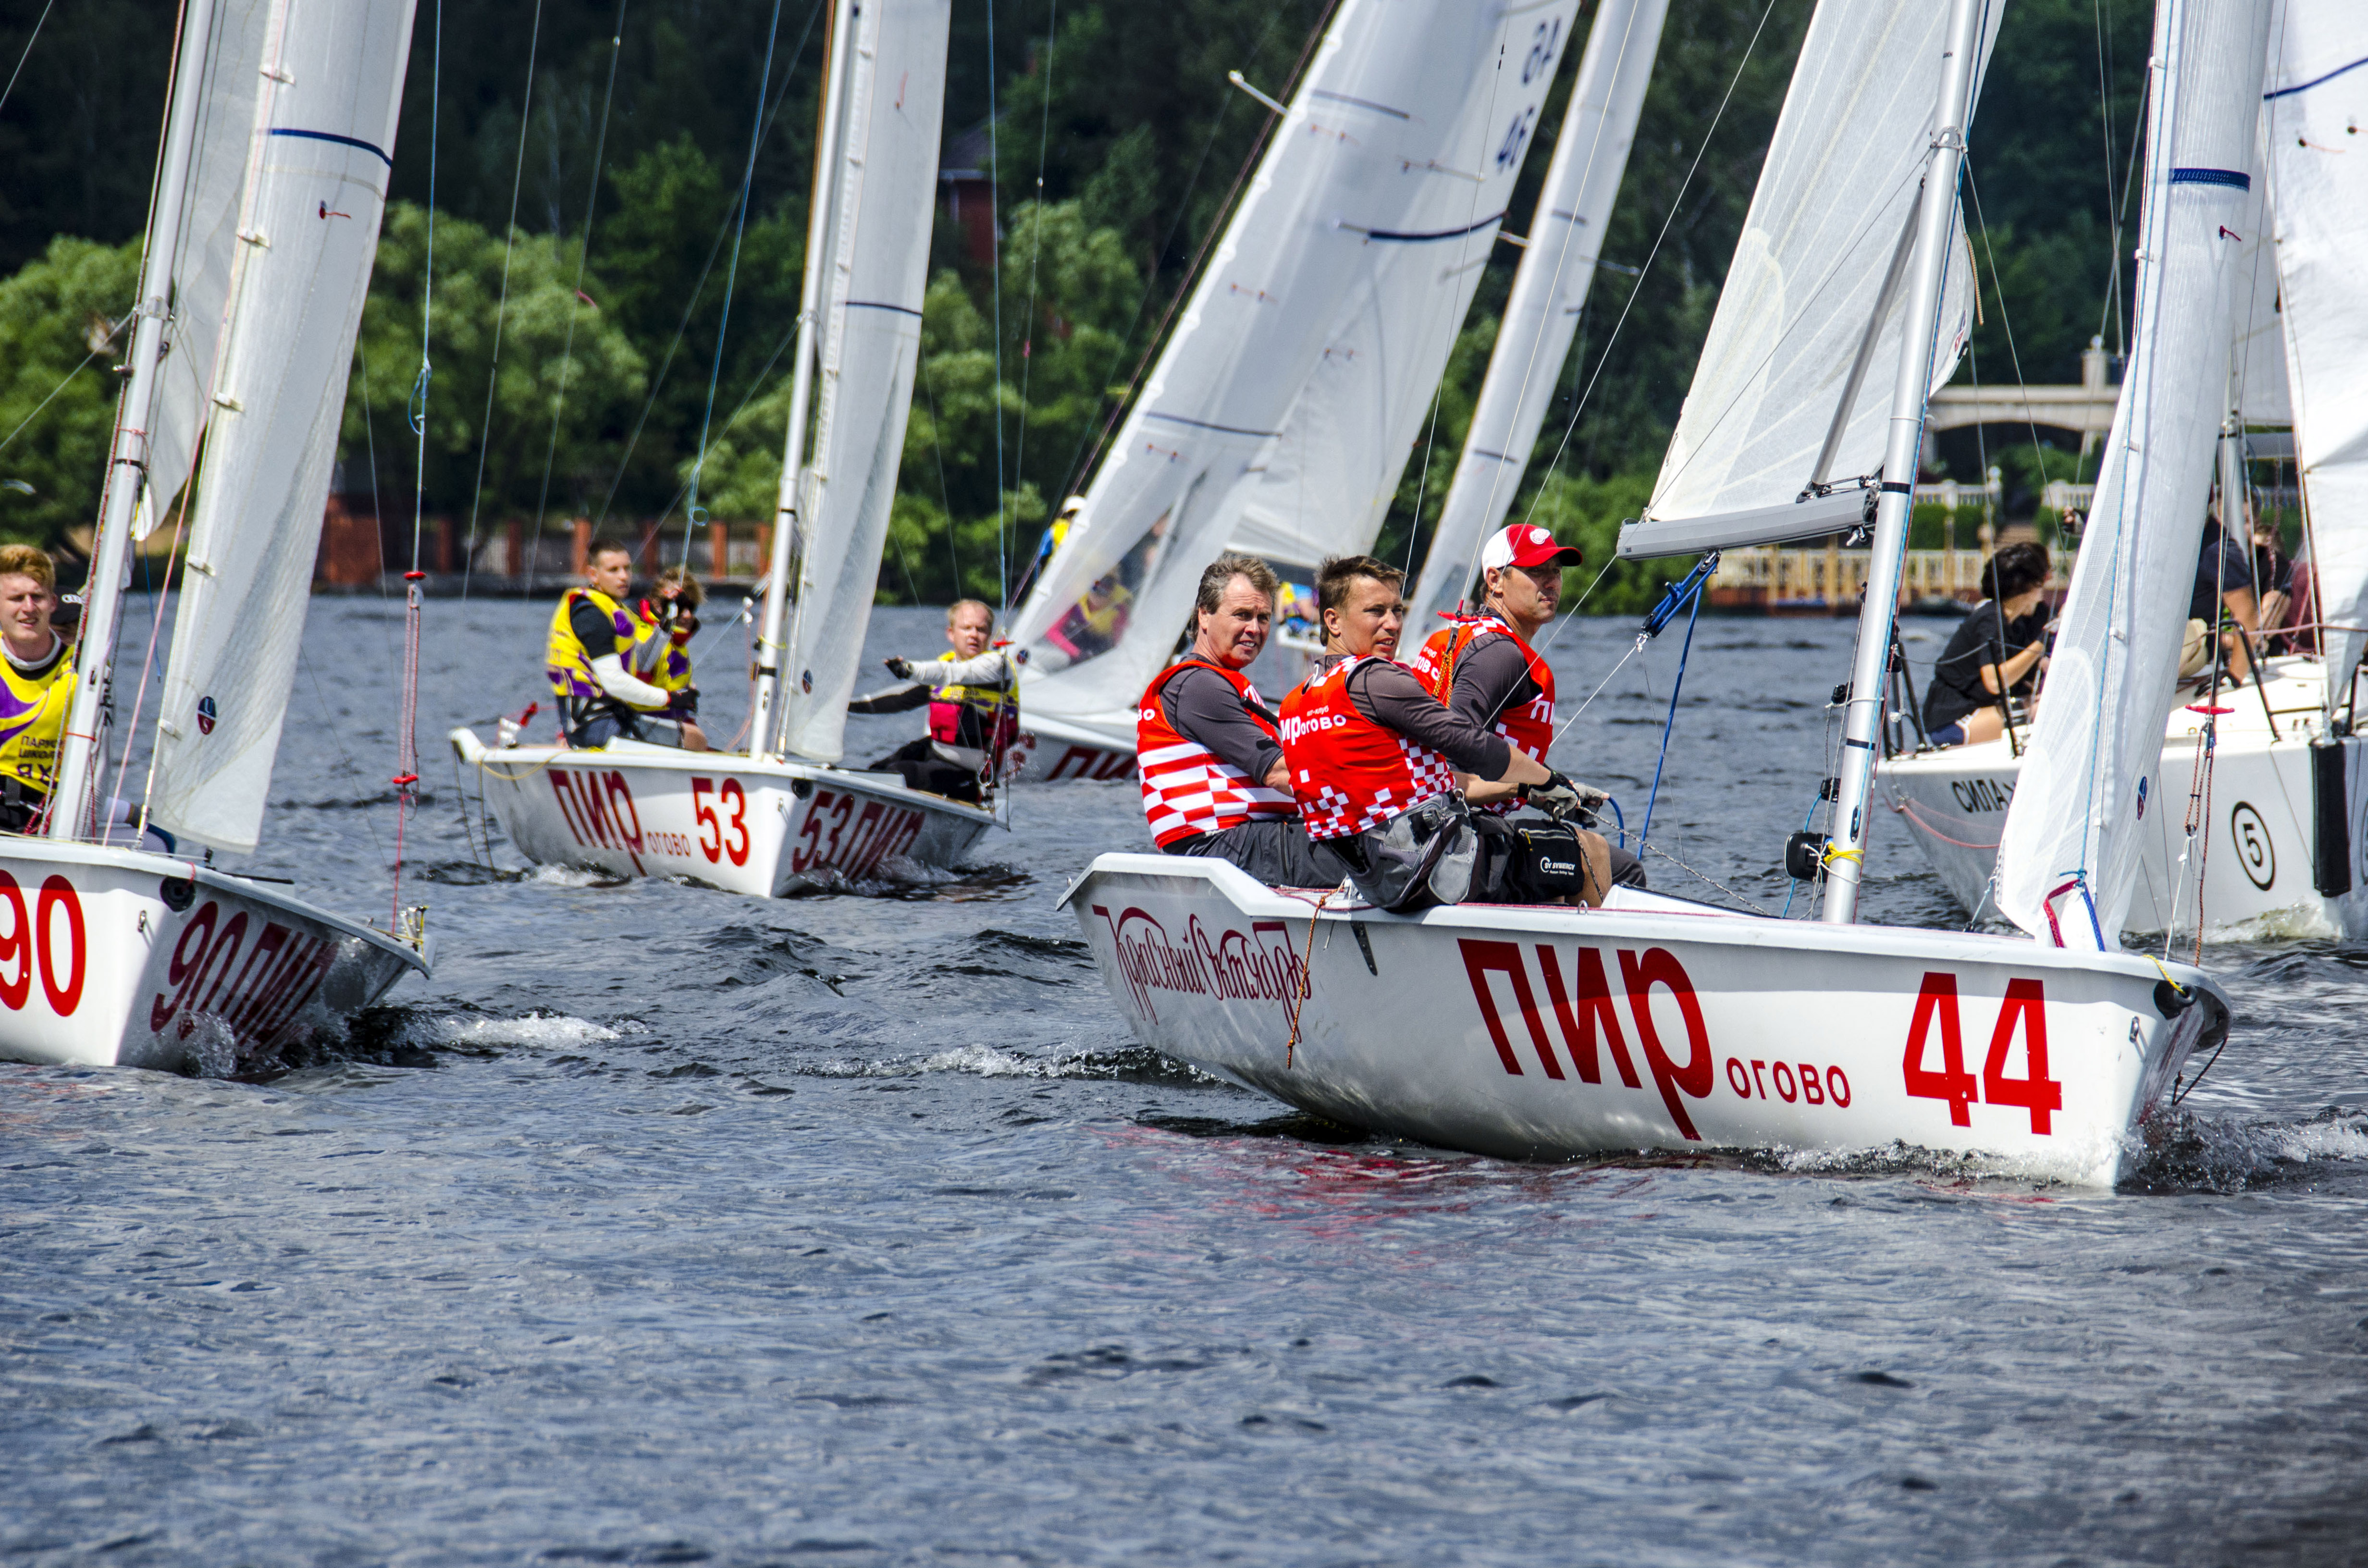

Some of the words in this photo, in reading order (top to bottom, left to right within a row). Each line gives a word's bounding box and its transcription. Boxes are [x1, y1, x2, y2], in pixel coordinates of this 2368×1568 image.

[691, 777, 751, 867] 53
[792, 790, 855, 873] 53
[1952, 778, 2010, 813] СИЛА
[1552, 862, 1575, 870] SYNERGY
[2243, 823, 2264, 868] 5
[0, 870, 86, 1017] 90
[151, 901, 248, 1040] 90
[1903, 972, 2062, 1135] 44
